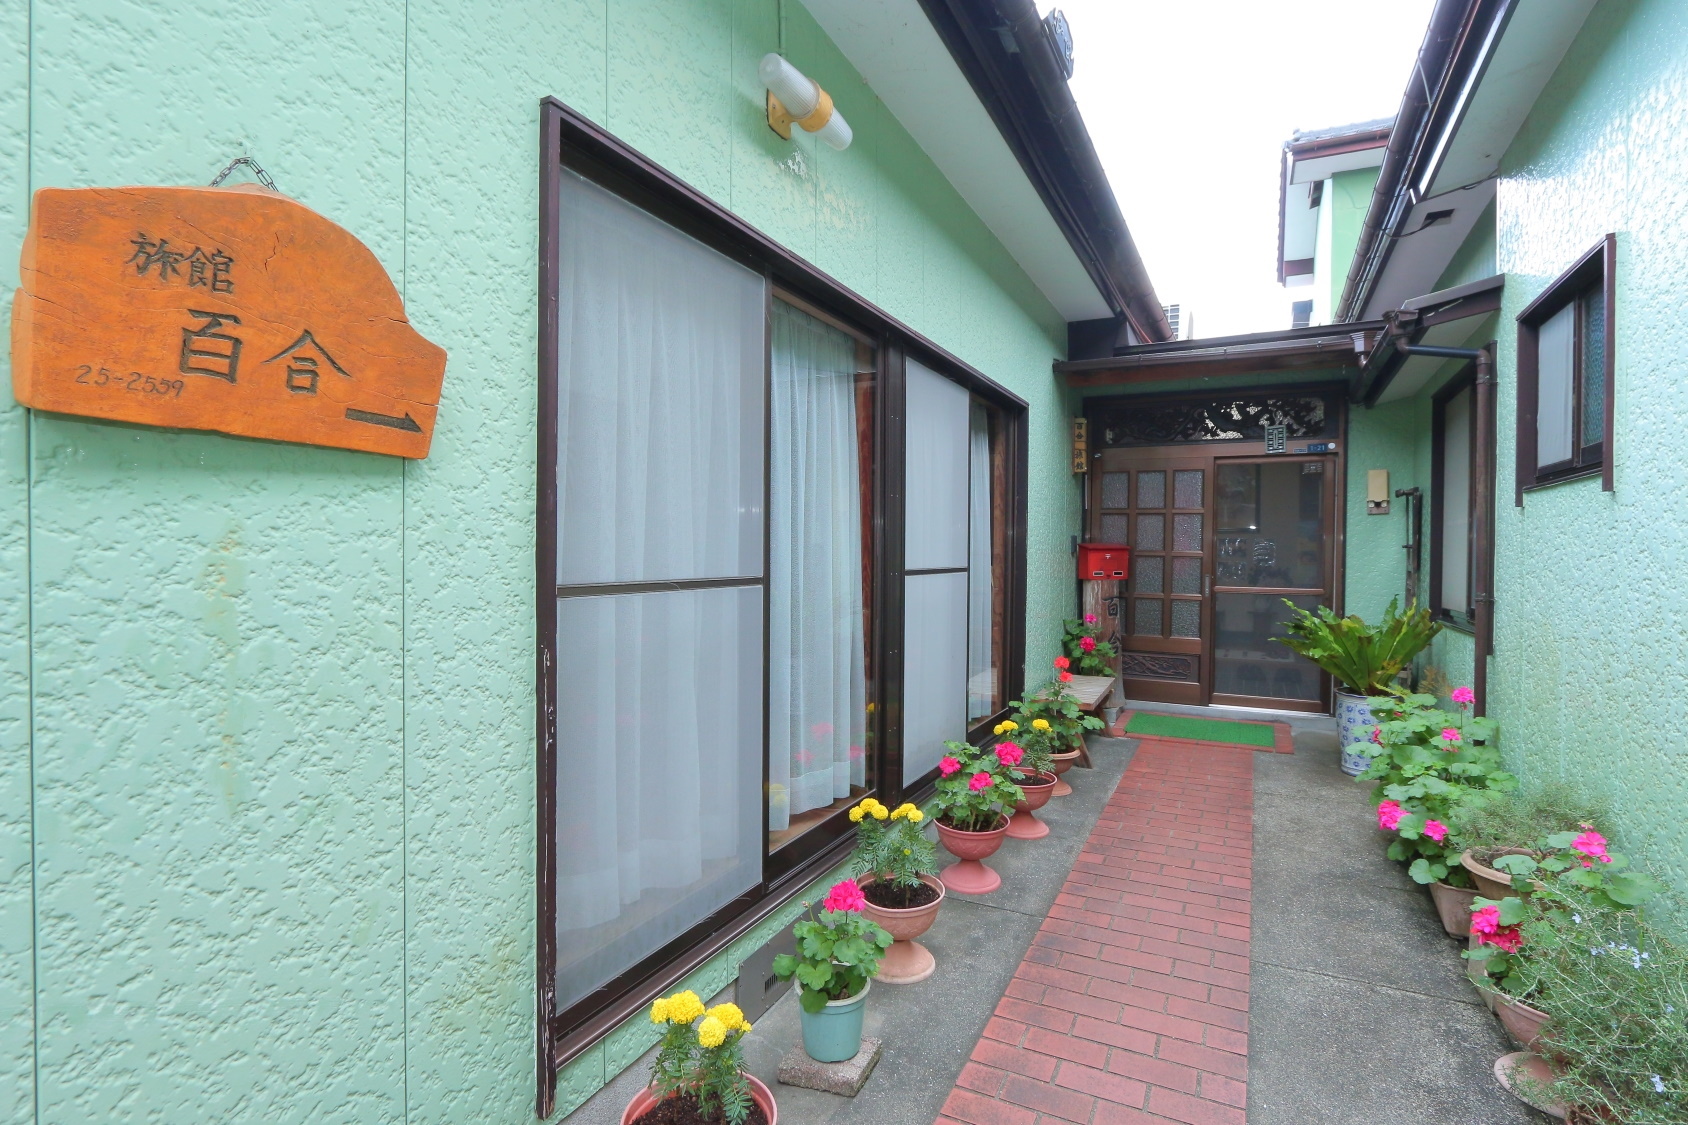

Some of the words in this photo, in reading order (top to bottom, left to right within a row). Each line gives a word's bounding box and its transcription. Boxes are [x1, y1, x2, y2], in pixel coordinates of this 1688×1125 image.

[126, 232, 234, 294] 旅館
[74, 364, 184, 397] 25-2559
[179, 308, 352, 395] 百合
